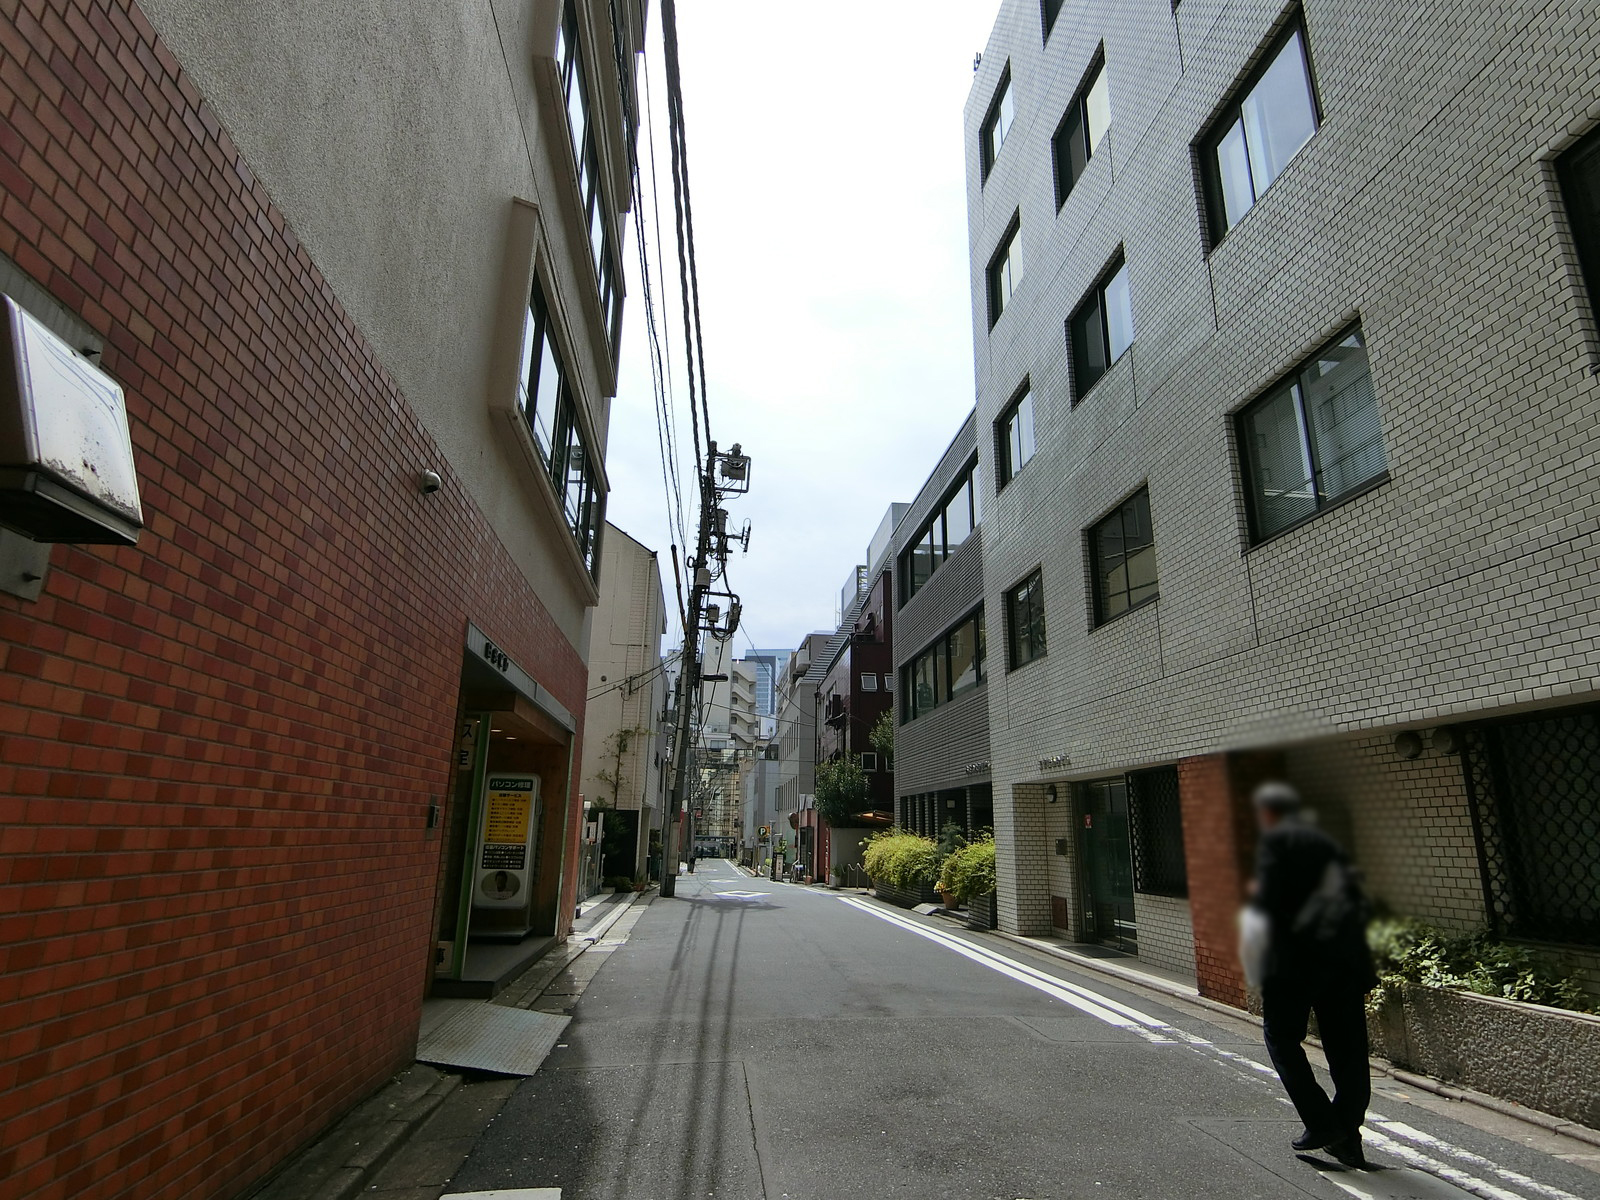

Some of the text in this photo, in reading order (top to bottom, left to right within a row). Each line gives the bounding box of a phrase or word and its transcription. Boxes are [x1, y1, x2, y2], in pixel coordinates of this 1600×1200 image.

[491, 780, 532, 789] パソコン修理
